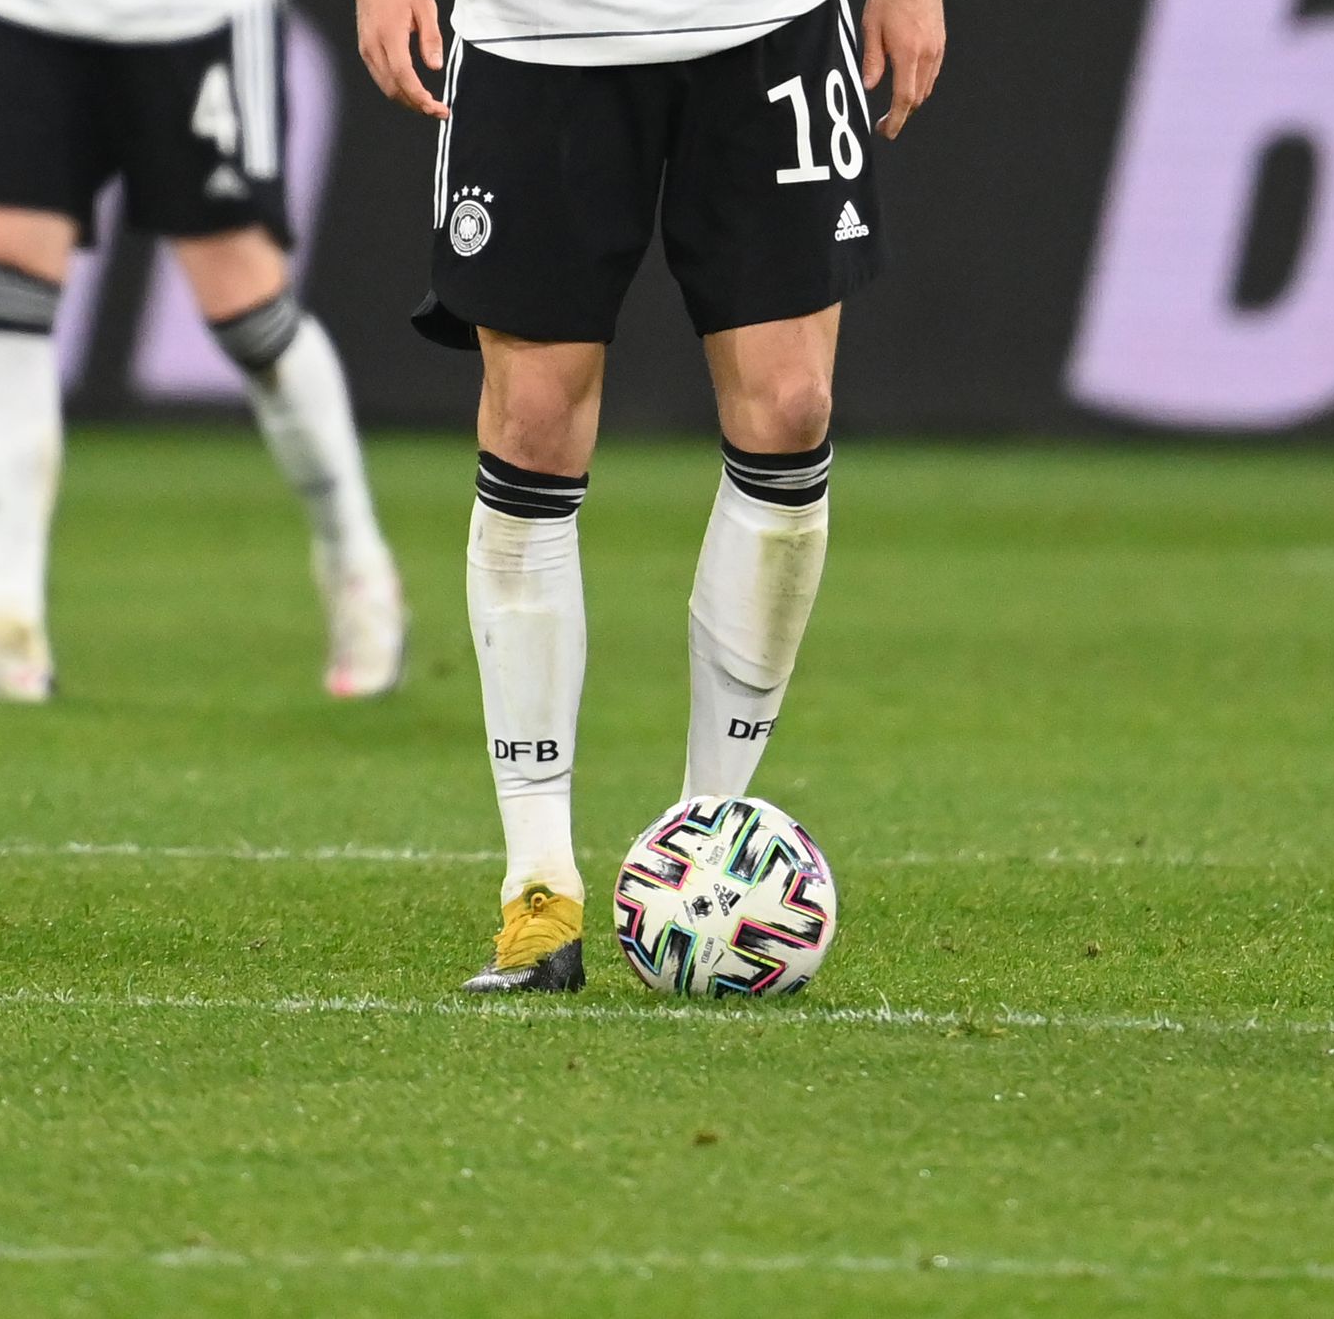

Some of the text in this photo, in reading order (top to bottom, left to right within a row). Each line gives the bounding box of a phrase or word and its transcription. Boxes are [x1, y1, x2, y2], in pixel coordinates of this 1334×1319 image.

[192, 62, 238, 156] 4
[767, 68, 864, 184] 18
[834, 224, 870, 242] adidas
[494, 739, 559, 762] DFB
